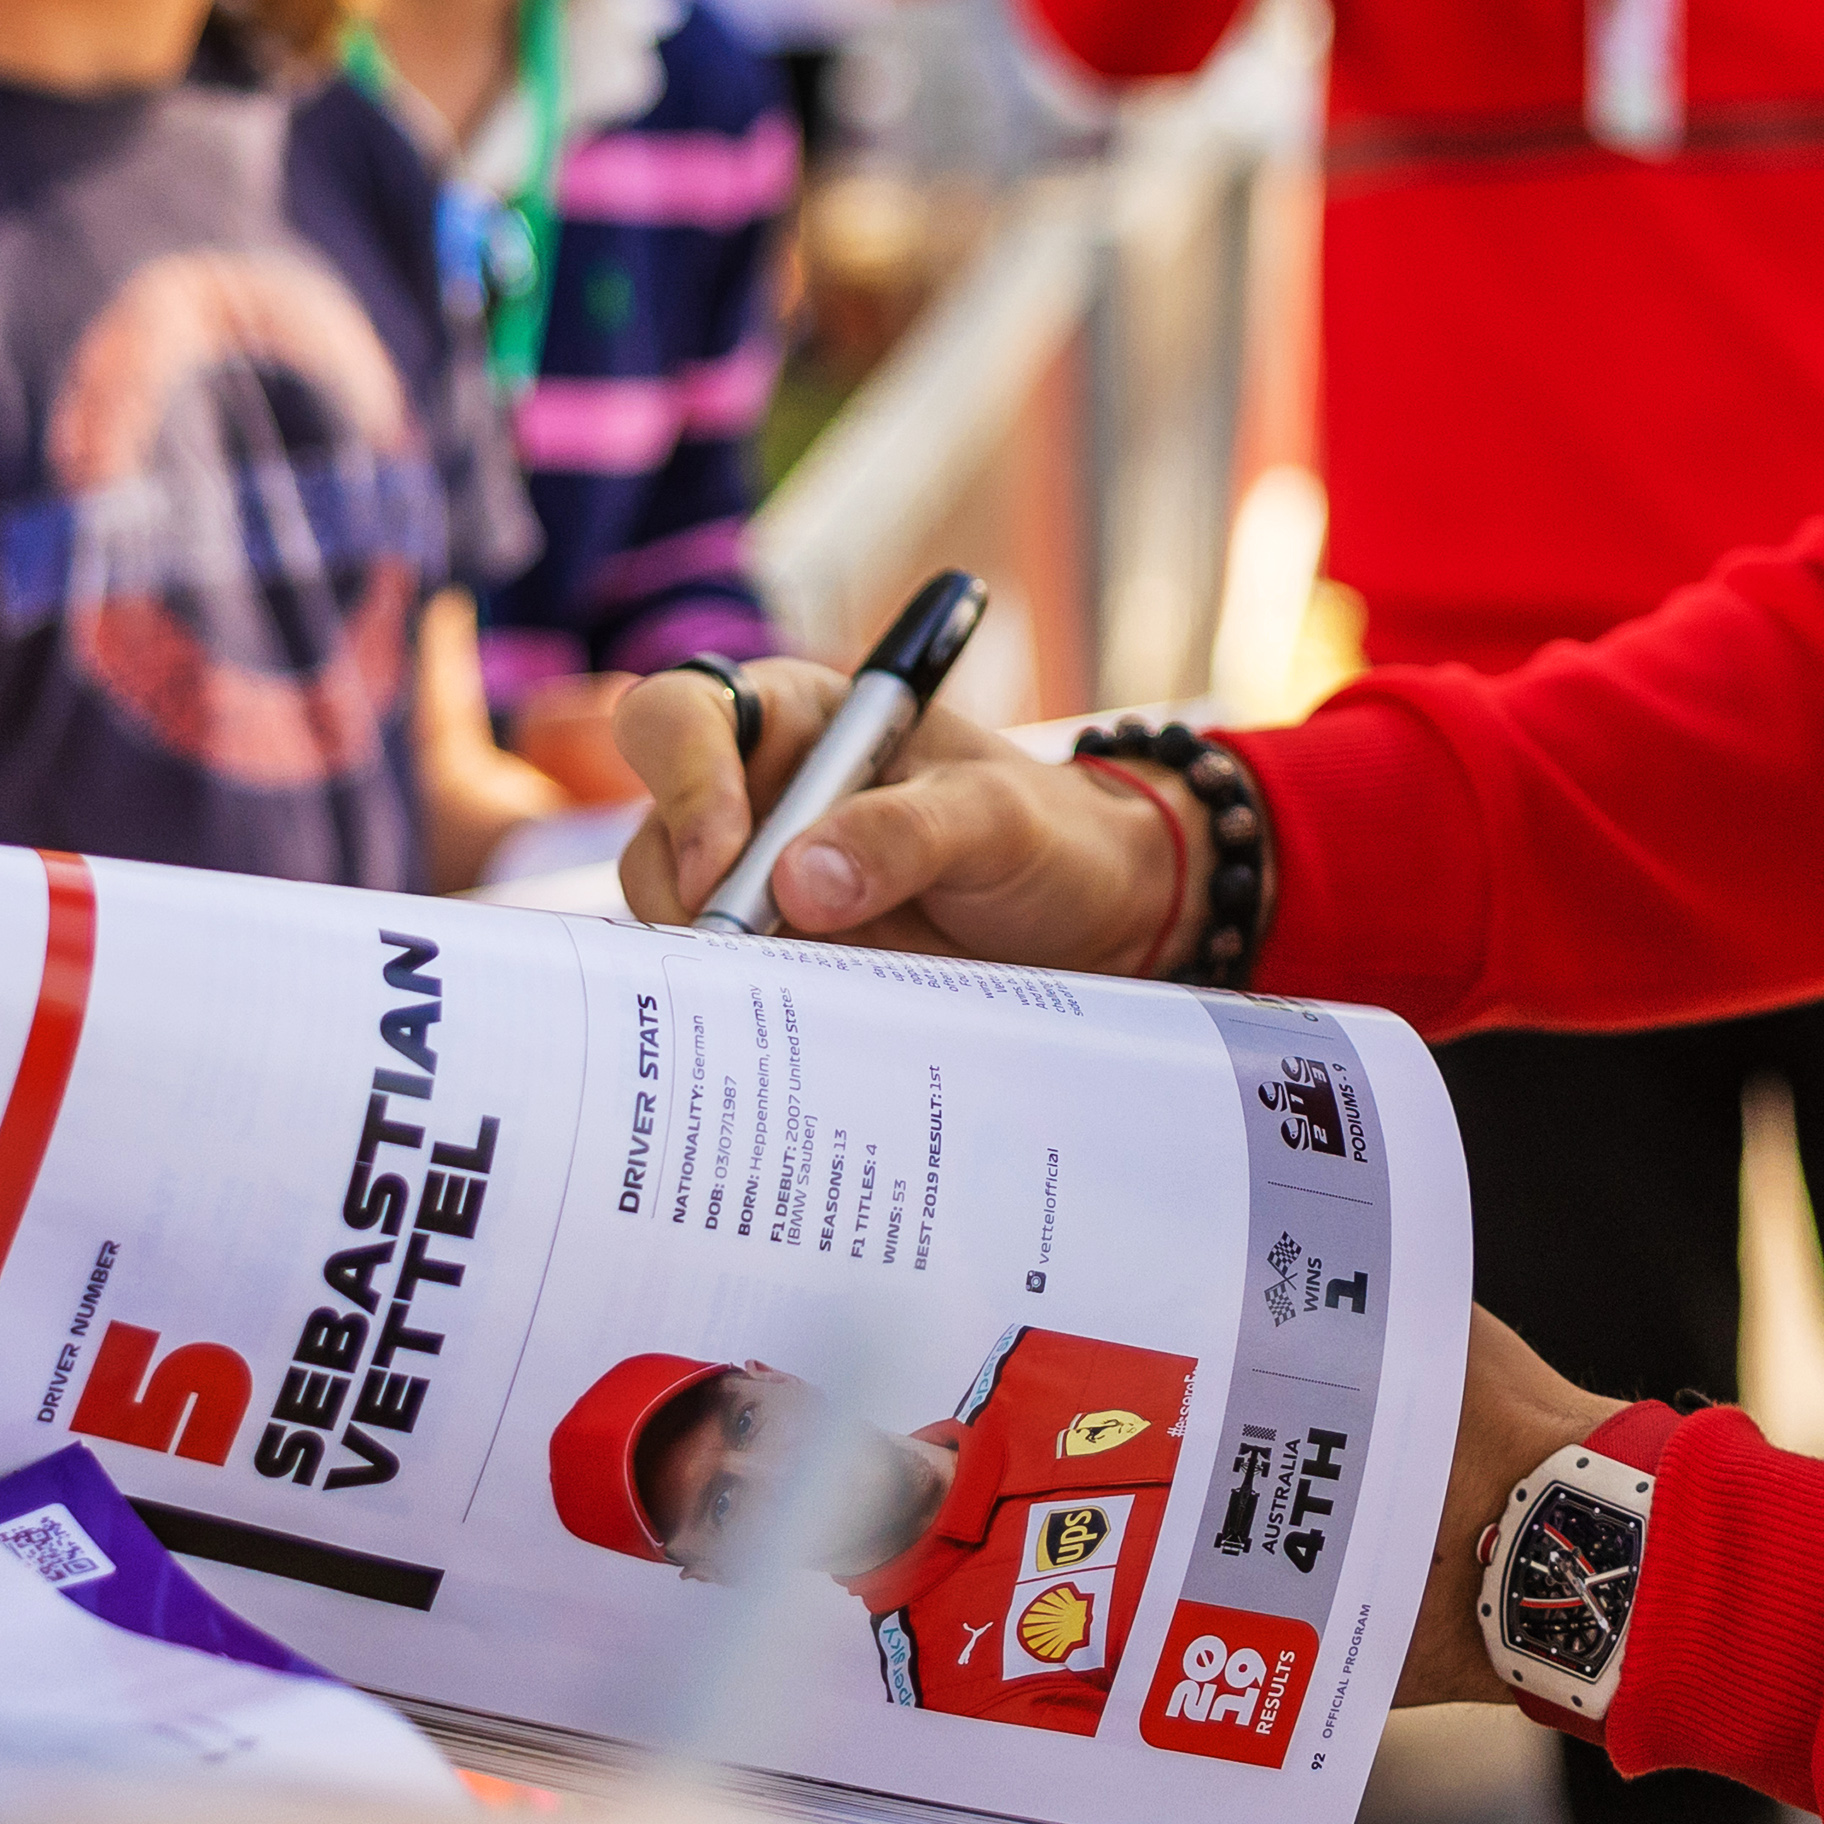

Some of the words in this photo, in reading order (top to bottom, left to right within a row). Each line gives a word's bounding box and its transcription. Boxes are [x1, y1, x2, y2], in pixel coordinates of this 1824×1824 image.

[637, 994, 659, 1080] STATS
[749, 984, 768, 1050] Germany
[780, 987, 799, 1034] States
[789, 1036, 801, 1091] United
[930, 1064, 941, 1090] 1st
[1332, 1063, 1347, 1071] 9
[673, 1084, 705, 1223] NATIONALITY:
[693, 1015, 705, 1080] German
[750, 1054, 771, 1170] Heppenheim,
[785, 1095, 801, 1142] 2007
[797, 1114, 818, 1186] Sauber)
[866, 1143, 878, 1156] 4
[928, 1093, 942, 1169] RESULT:
[1338, 1084, 1368, 1163] PODIUMS
[618, 1091, 657, 1213] DRIVER
[705, 1183, 725, 1230] DOB:
[715, 1076, 737, 1179] 03/07/1987
[776, 1146, 798, 1217] DEBUT:
[819, 1154, 845, 1252] SEASONS:
[834, 1129, 847, 1151] 13
[254, 928, 443, 1486] SEBASTIAN
[738, 1175, 760, 1236] BORN:
[770, 1221, 785, 1243] F1
[855, 1159, 876, 1232] TITLES:
[883, 1205, 903, 1264] WINS:
[893, 1179, 906, 1202] 53
[923, 1172, 938, 1218] 2019
[1039, 1147, 1059, 1264] vettelofficial
[851, 1237, 865, 1258] F1
[914, 1222, 932, 1270] BEST
[321, 1115, 501, 1491] VETTEL
[1304, 1257, 1323, 1313] WINS
[1326, 1270, 1369, 1314] 1
[37, 1342, 81, 1423] DRIVER
[71, 1240, 121, 1336] NUMBER
[68, 1318, 253, 1467] 5
[1261, 1439, 1300, 1555] AUSTRALIA
[1283, 1427, 1348, 1573] 4TH
[1056, 1510, 1098, 1564] ups
[1165, 1635, 1228, 1722] 20
[1208, 1647, 1268, 1726] 19
[1256, 1650, 1296, 1735] RESULTS
[1311, 1753, 1326, 1770] 92
[1322, 1678, 1350, 1739] OFFICIAL
[1342, 1604, 1371, 1674] PROGRAM
